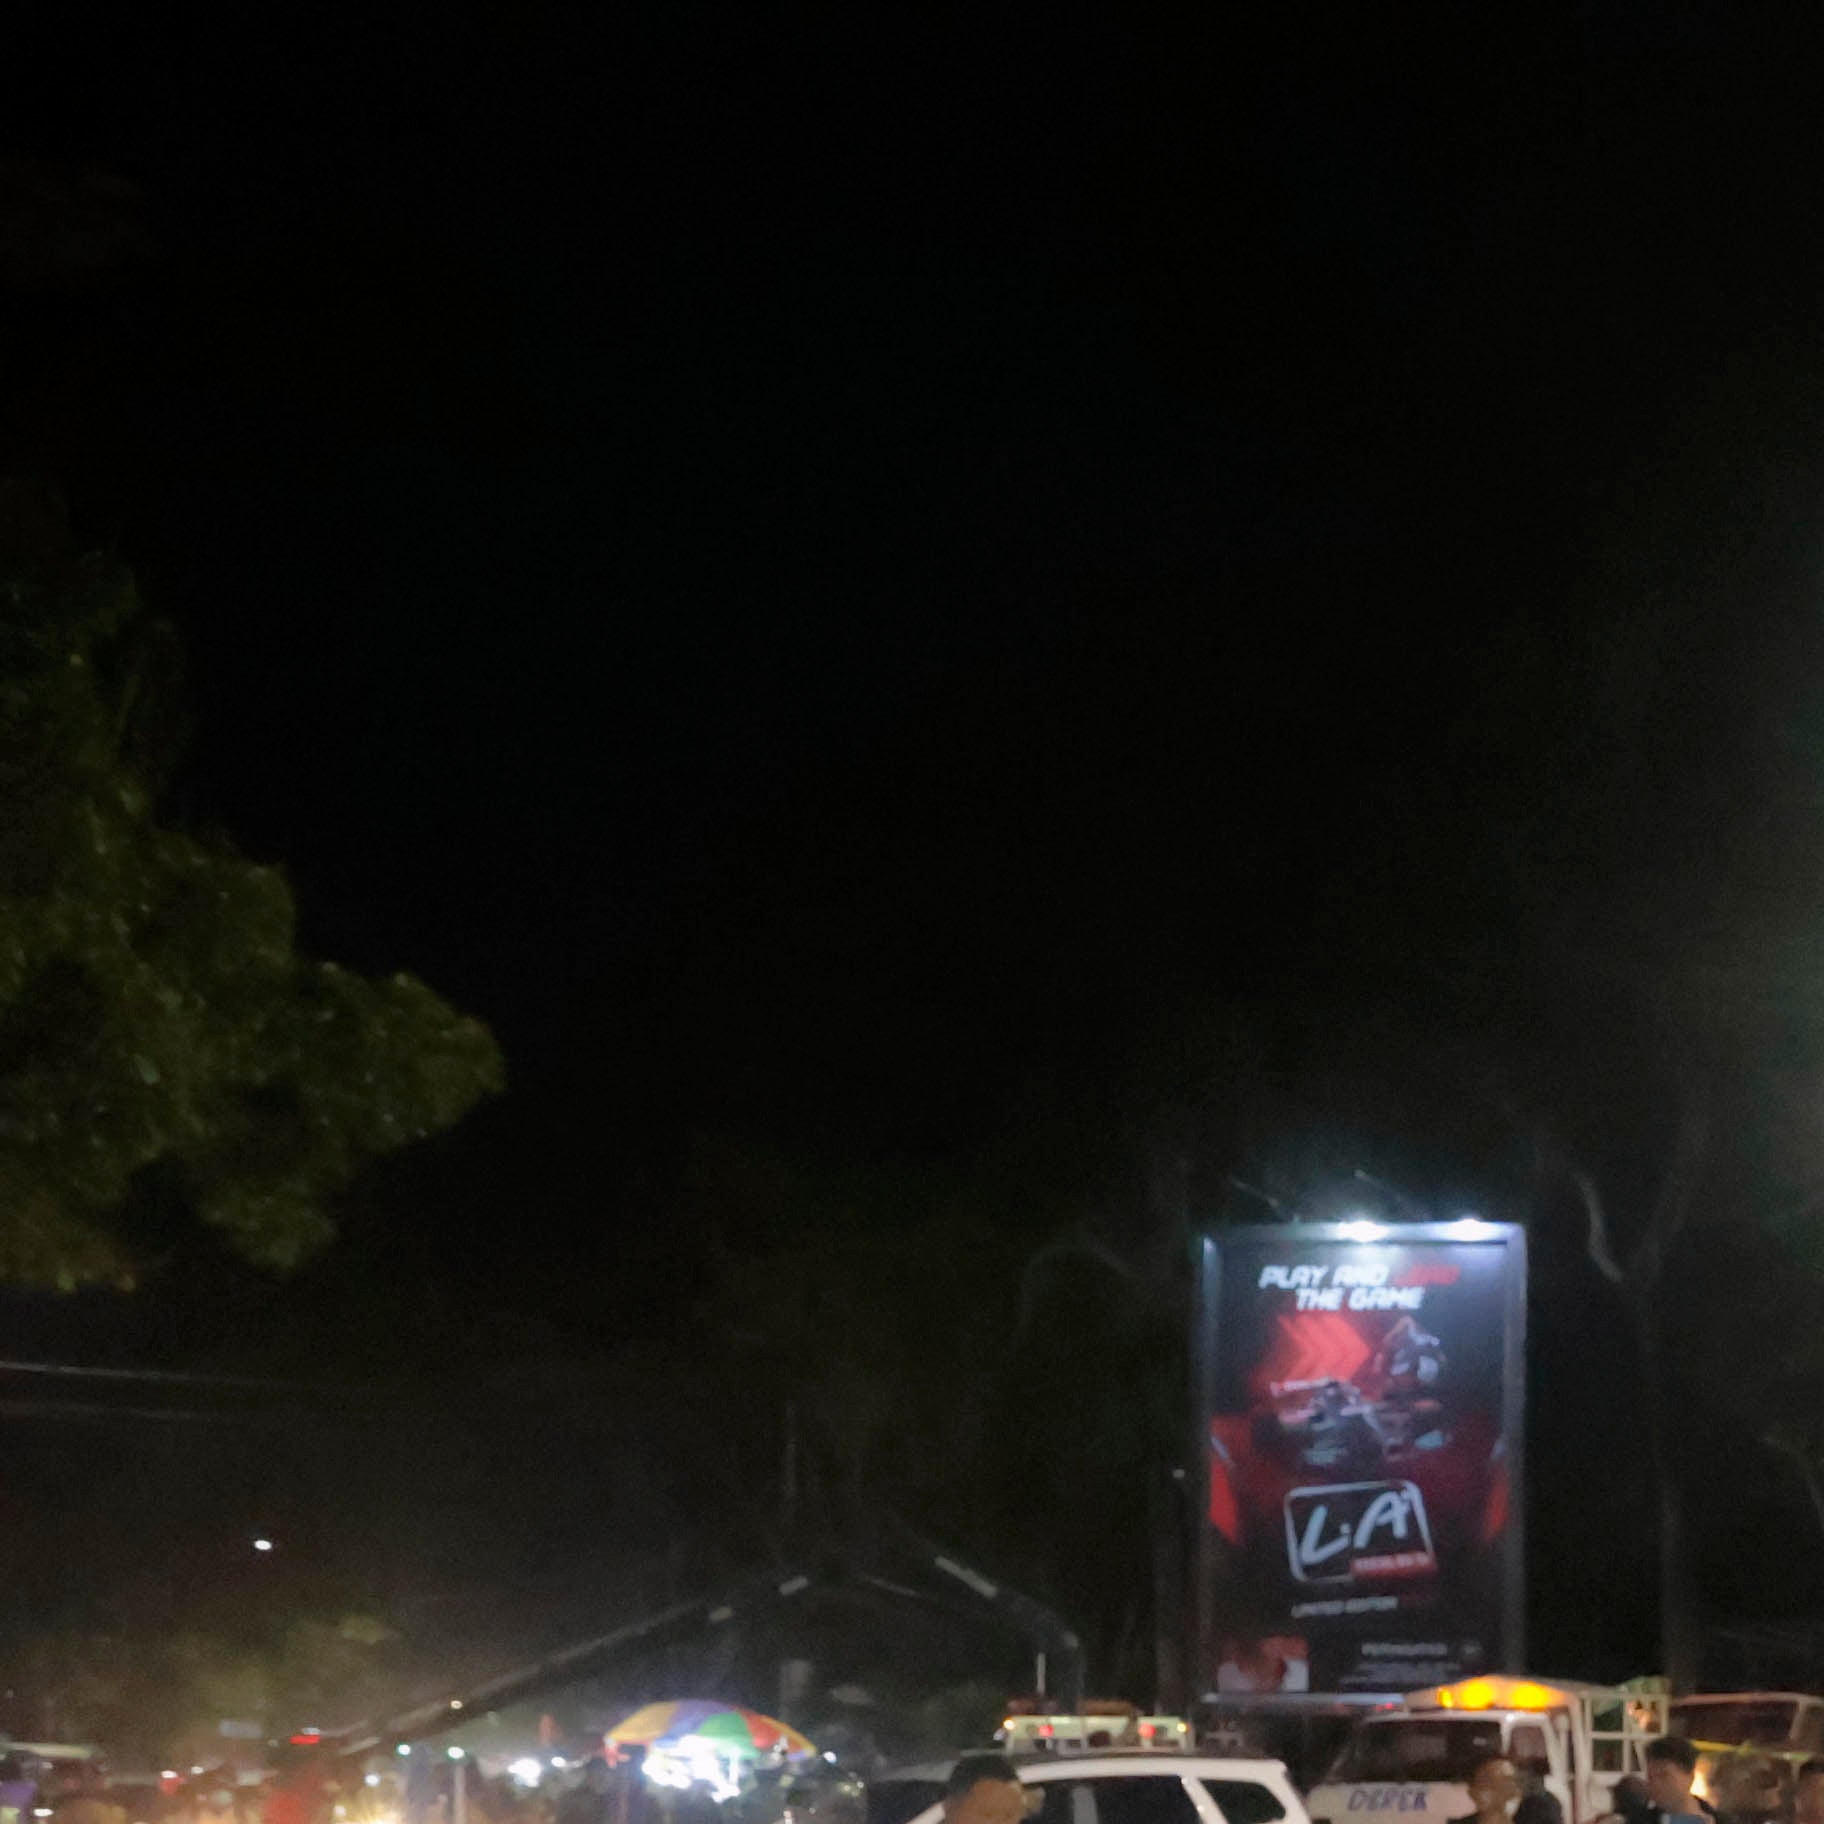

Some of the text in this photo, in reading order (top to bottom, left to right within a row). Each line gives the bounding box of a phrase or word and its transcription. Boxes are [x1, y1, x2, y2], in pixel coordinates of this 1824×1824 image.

[1258, 1265, 1329, 1290] PLAY
[1296, 1286, 1426, 1312] THE GAME
